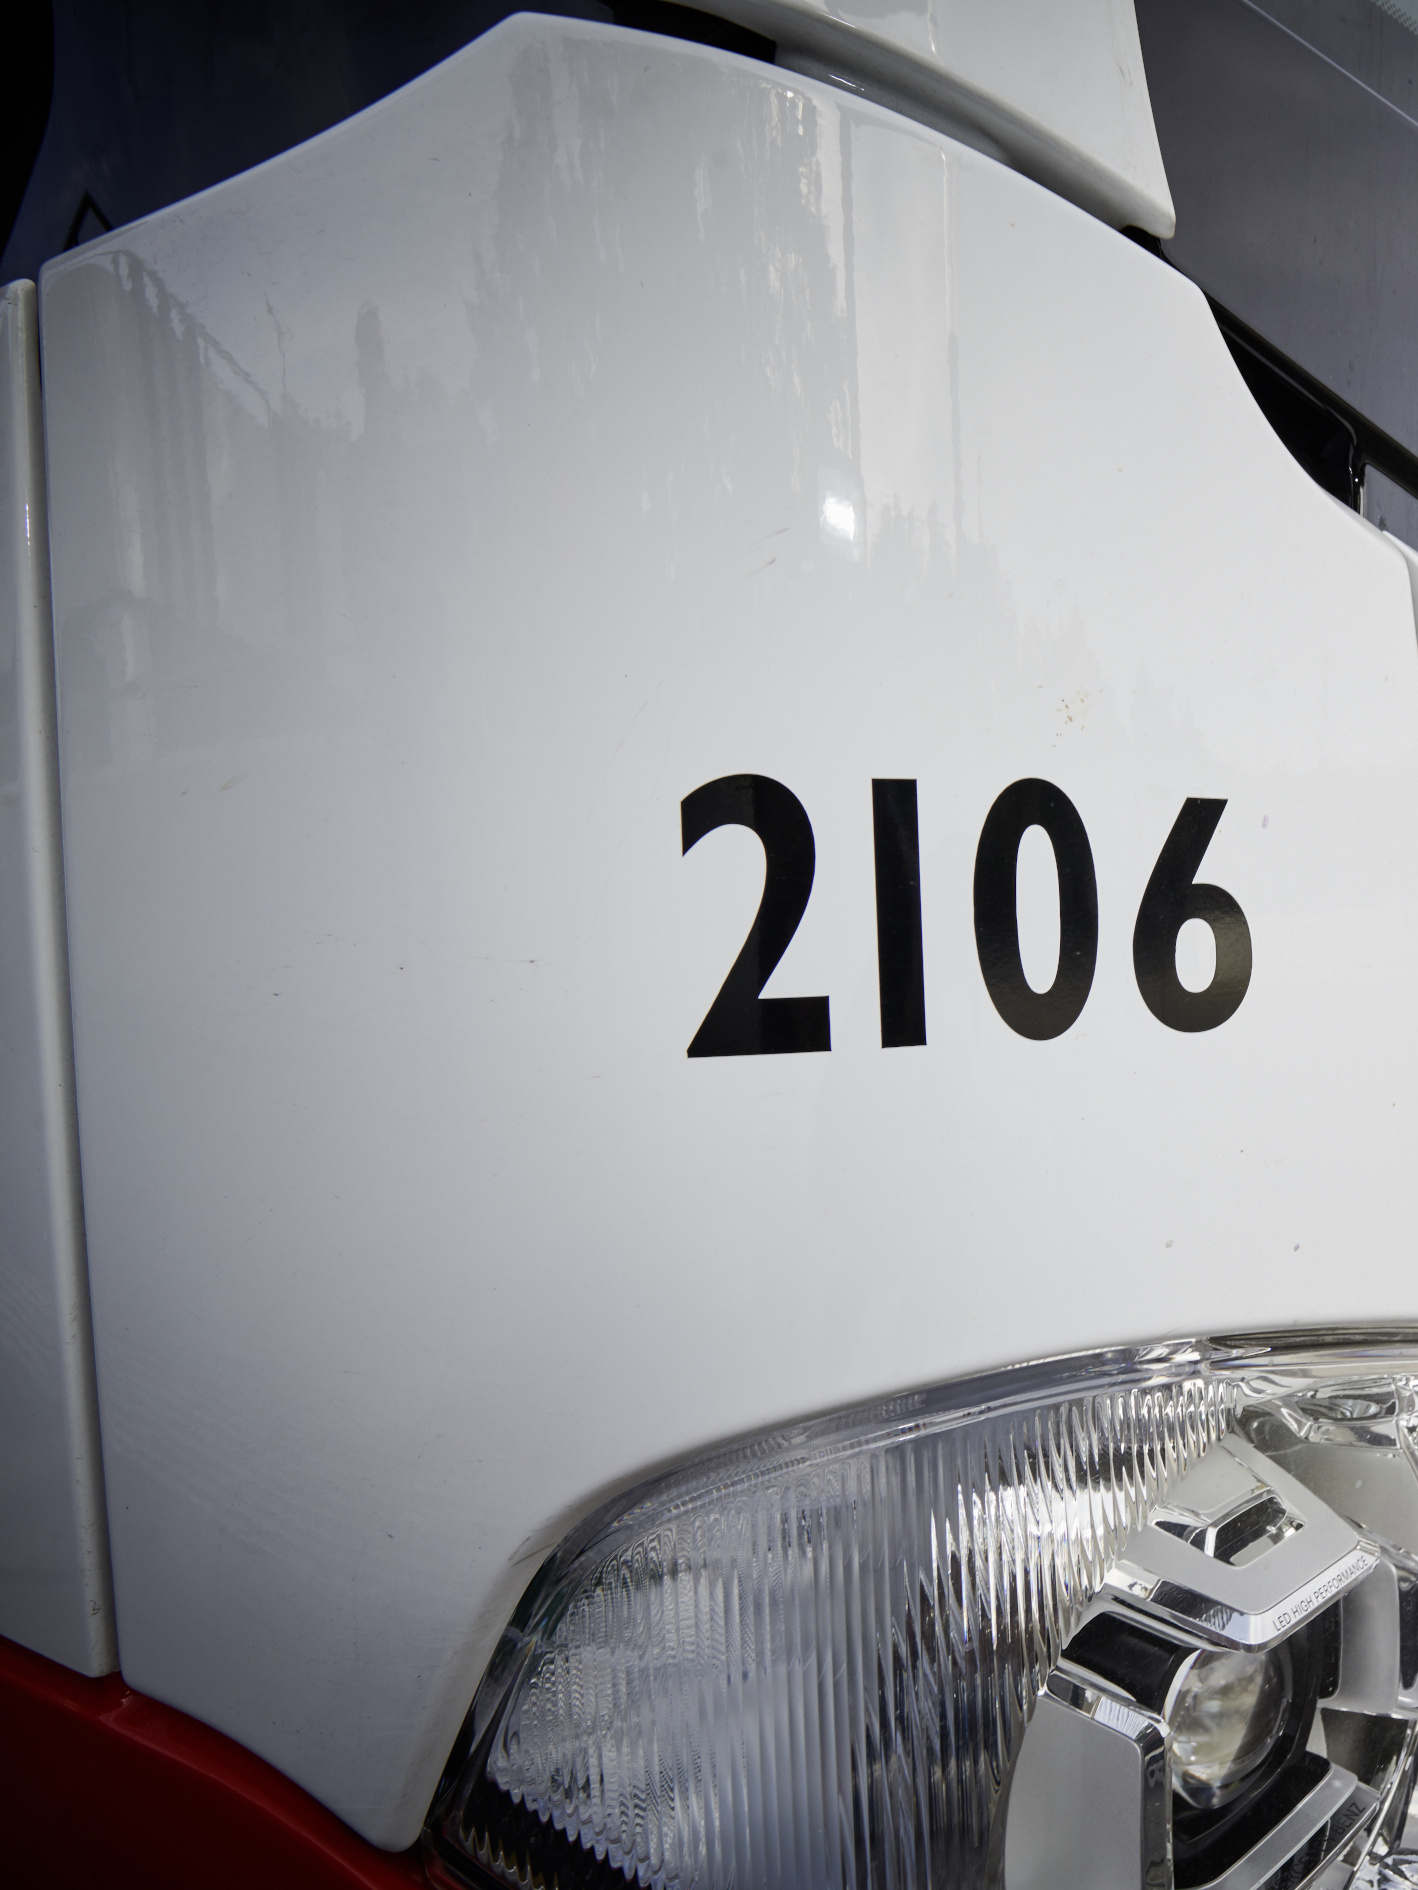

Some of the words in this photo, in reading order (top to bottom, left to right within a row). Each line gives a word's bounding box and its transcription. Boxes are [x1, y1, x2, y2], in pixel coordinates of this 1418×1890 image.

[681, 774, 1252, 1058] 2106
[1272, 1611, 1292, 1632] LED
[1291, 1595, 1315, 1619] HIGH
[1313, 1555, 1369, 1603] PERFORMANCE
